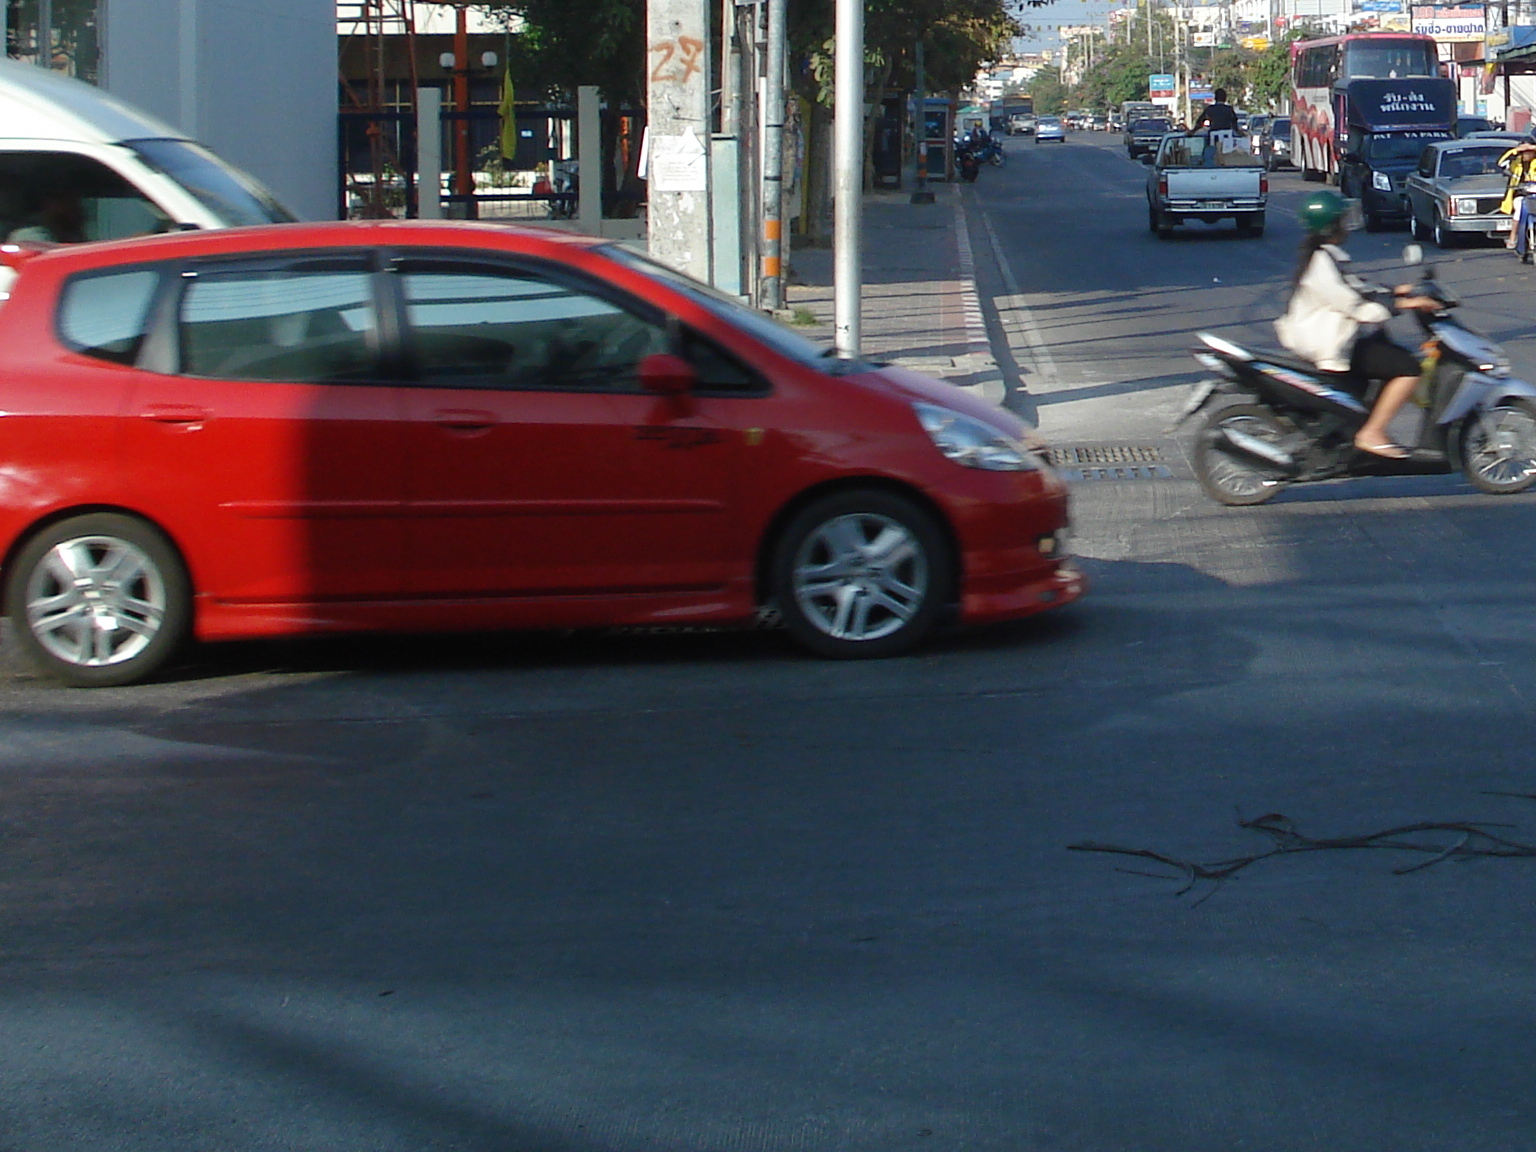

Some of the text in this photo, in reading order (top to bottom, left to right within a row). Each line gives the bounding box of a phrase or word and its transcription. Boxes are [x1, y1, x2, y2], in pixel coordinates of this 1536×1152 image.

[650, 35, 704, 84] 27
[1380, 102, 1436, 113] พนักงาน
